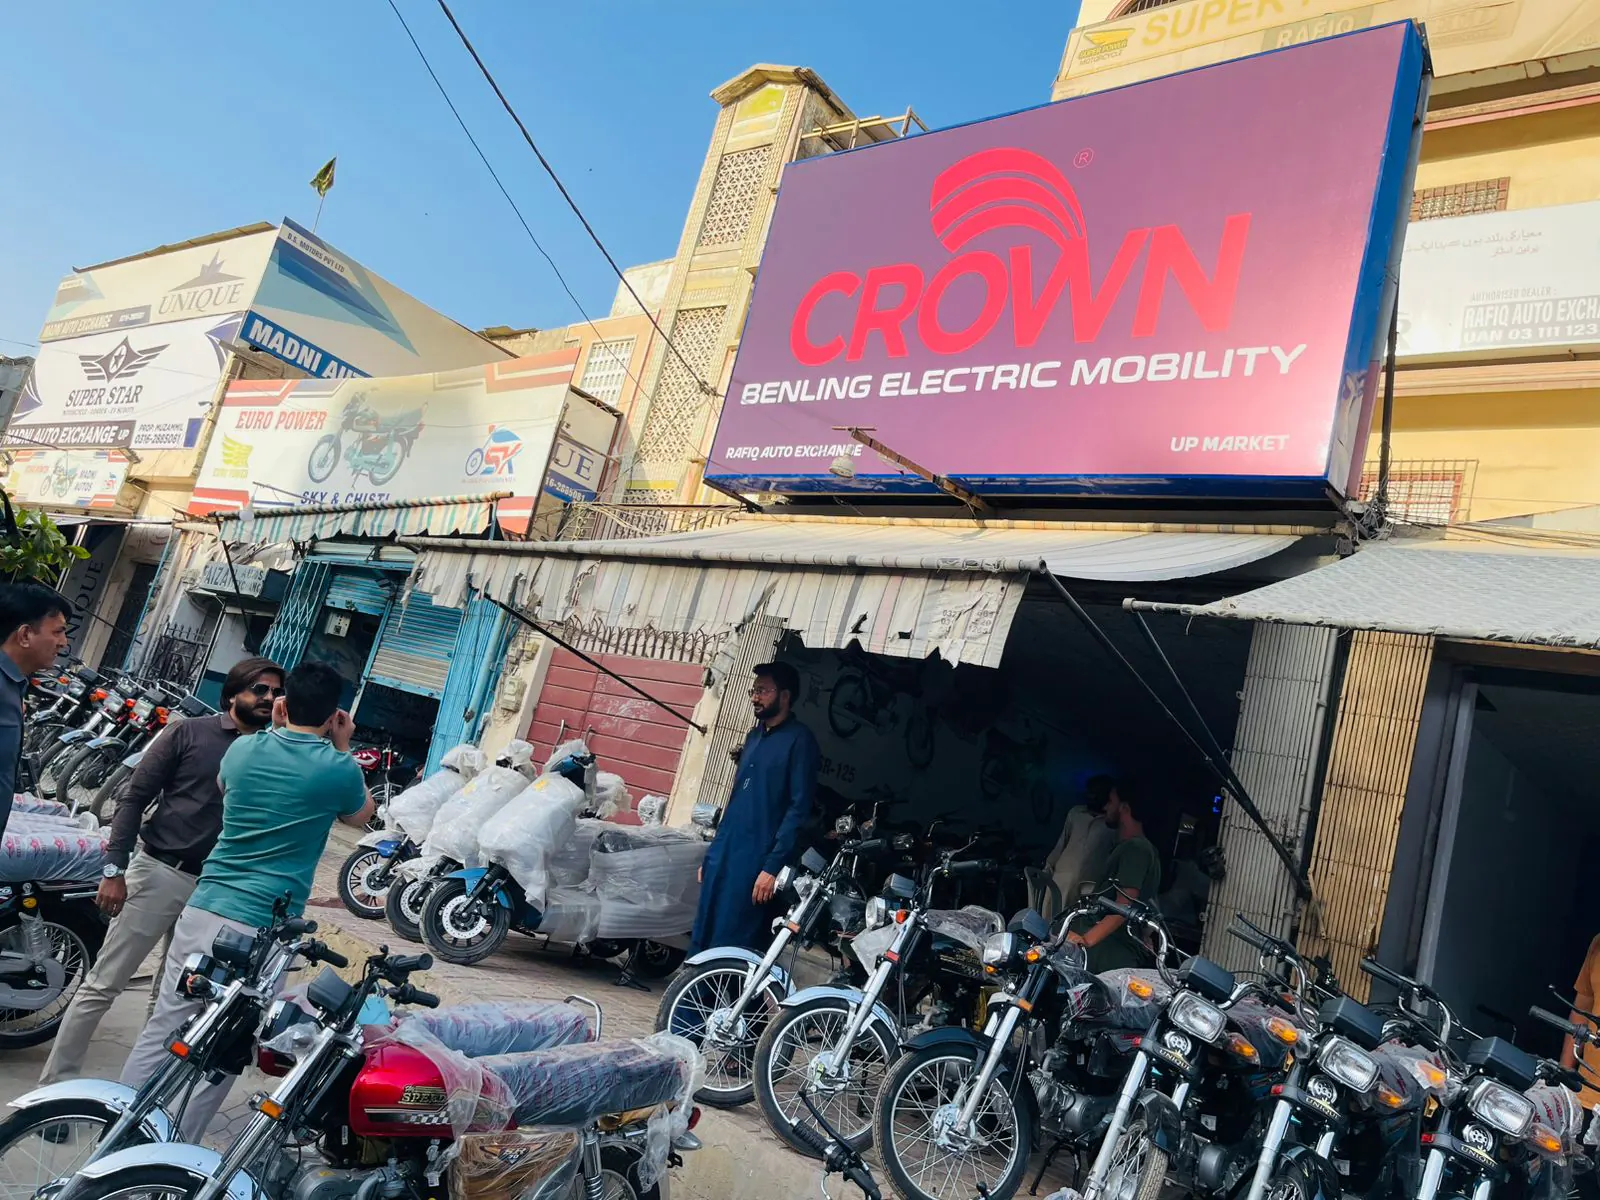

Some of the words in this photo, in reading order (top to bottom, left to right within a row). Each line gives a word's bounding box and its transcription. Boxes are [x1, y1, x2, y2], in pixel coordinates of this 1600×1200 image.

[299, 239, 324, 261] MOTORS
[158, 283, 245, 316] UNIQUE
[790, 212, 1252, 366] CROWN
[1464, 304, 1510, 329] RAFIQ
[1510, 301, 1553, 326] AUTO
[1463, 328, 1504, 344] UAN
[1508, 328, 1533, 340] 03
[1565, 323, 1599, 336] 123
[249, 319, 323, 373] MADNI
[740, 376, 873, 406] BENLING
[878, 361, 1062, 398] ELECTRIC
[1068, 344, 1308, 387] MOBILITY
[65, 387, 108, 409] SUPER
[106, 384, 144, 405] STAR
[235, 410, 275, 431] EURO
[274, 410, 329, 431] POWER
[34, 426, 60, 444] AUTO
[58, 425, 120, 444] EXCHANGE
[1170, 436, 1200, 452] UP
[1202, 434, 1290, 452] MARKET
[725, 447, 759, 460] RAFIQ
[759, 446, 793, 458] AUTO
[794, 443, 863, 458] EXCHANGE
